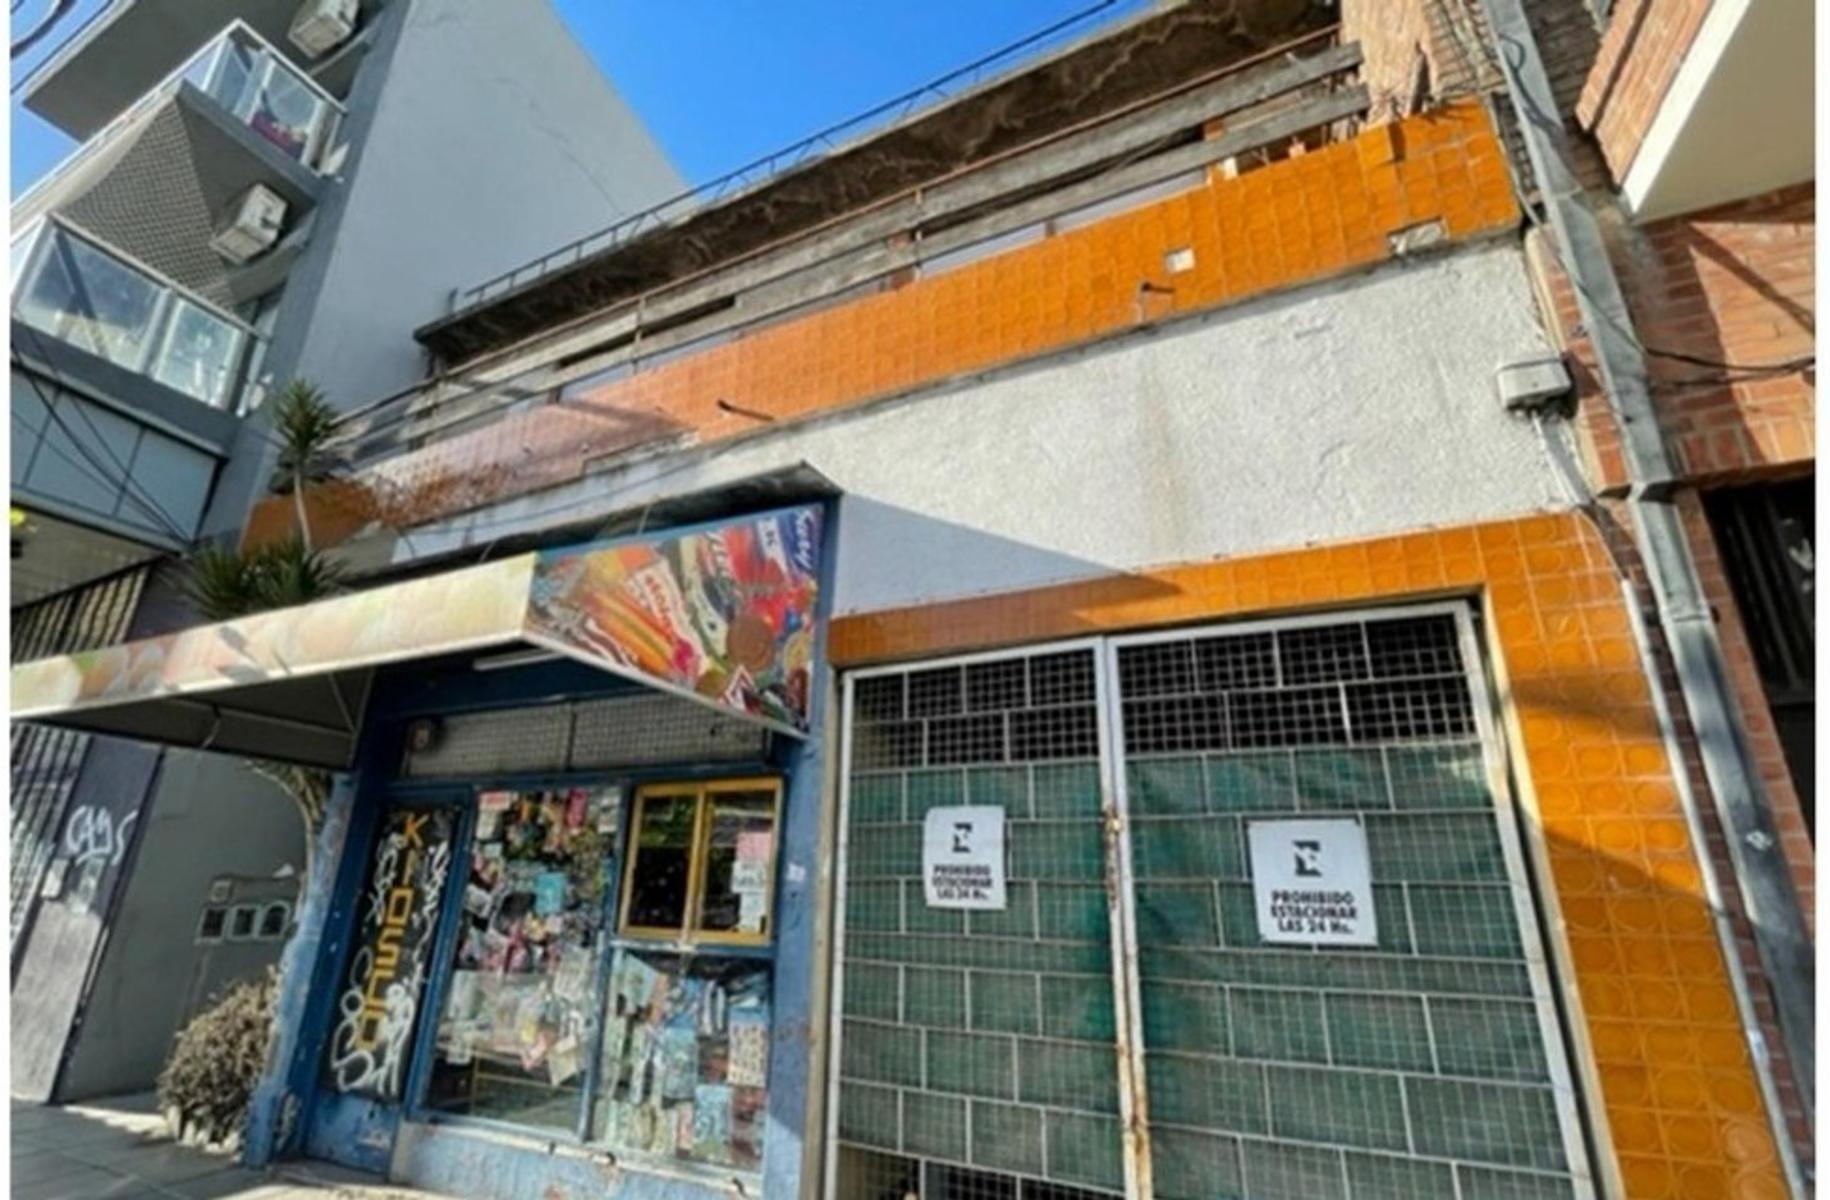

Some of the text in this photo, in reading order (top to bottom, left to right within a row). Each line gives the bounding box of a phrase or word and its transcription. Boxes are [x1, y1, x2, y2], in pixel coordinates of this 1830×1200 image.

[1272, 891, 1354, 904] PROHIBIDO
[1270, 905, 1357, 919] ESTACIONAR
[1278, 919, 1304, 934] LAS
[1307, 919, 1326, 934] 24
